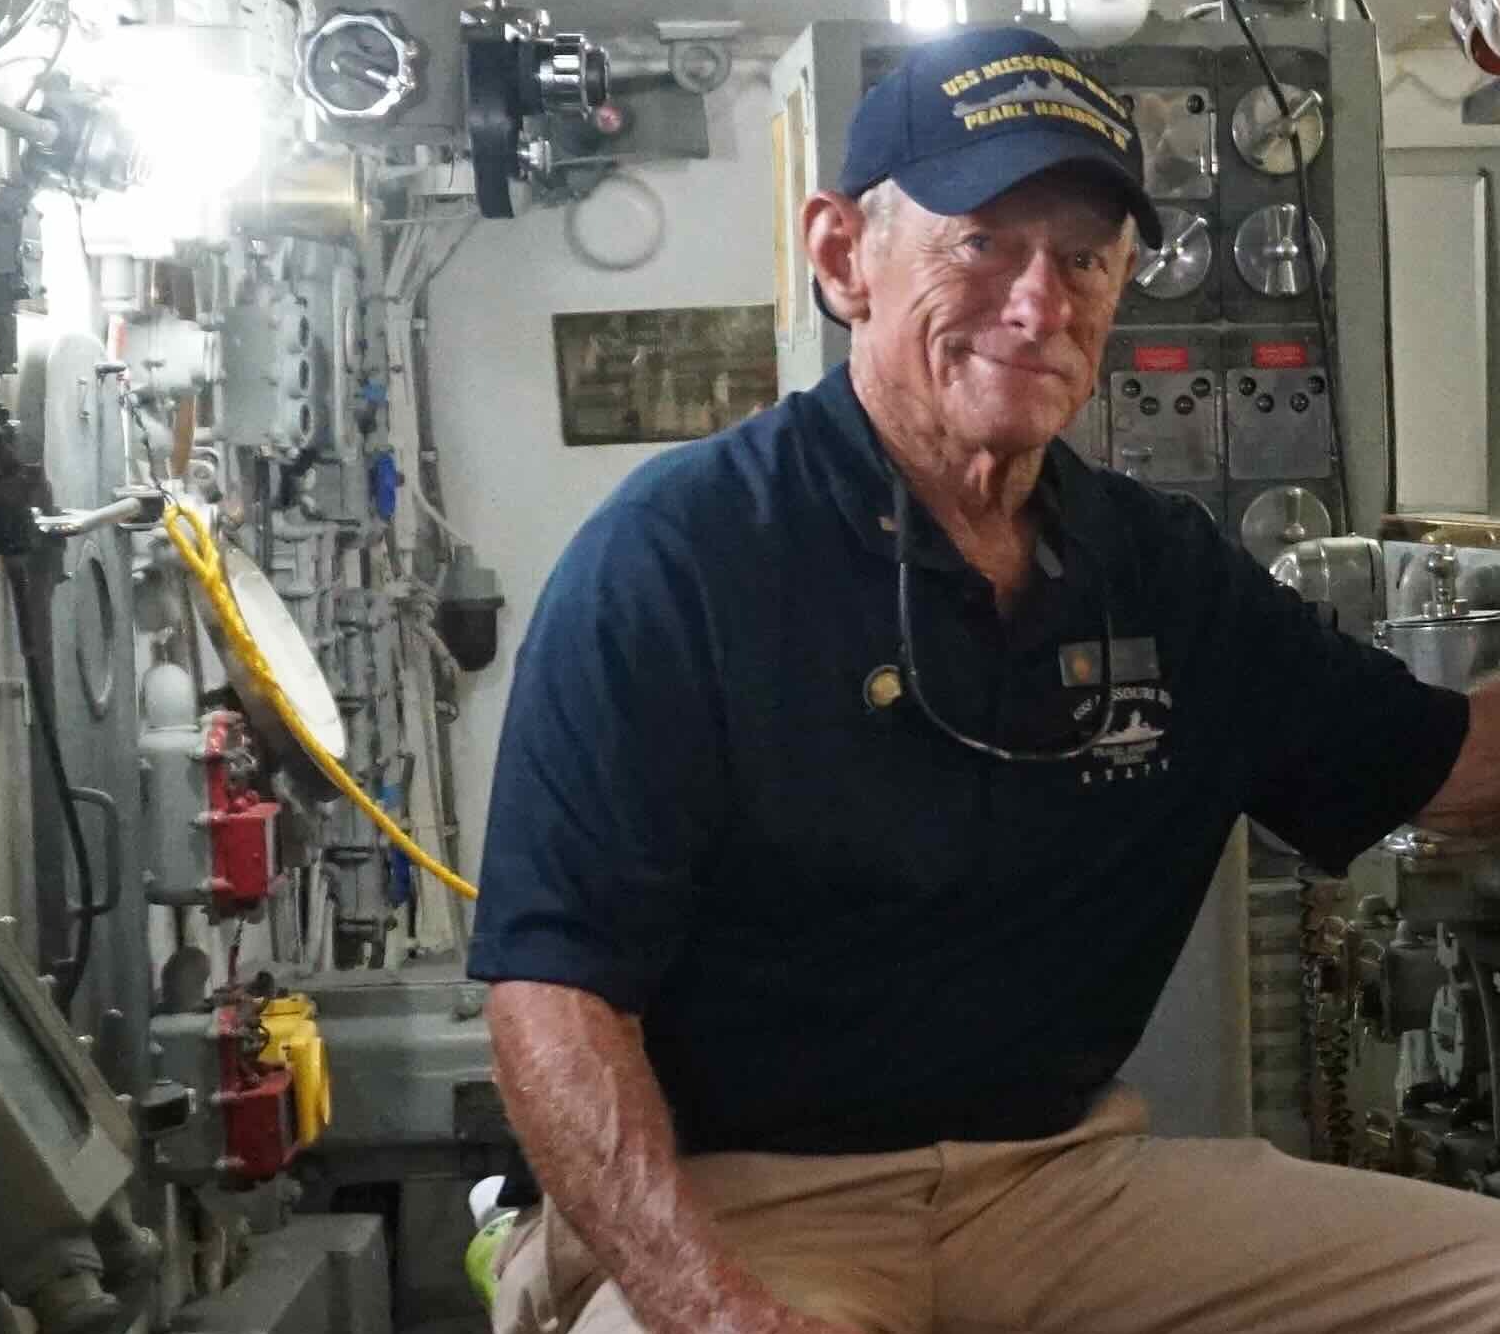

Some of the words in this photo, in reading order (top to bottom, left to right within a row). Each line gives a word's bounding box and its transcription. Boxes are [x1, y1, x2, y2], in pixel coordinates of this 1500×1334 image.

[941, 70, 980, 96] USS
[981, 55, 1083, 82] MISSOURI
[964, 103, 1029, 130] PEARL
